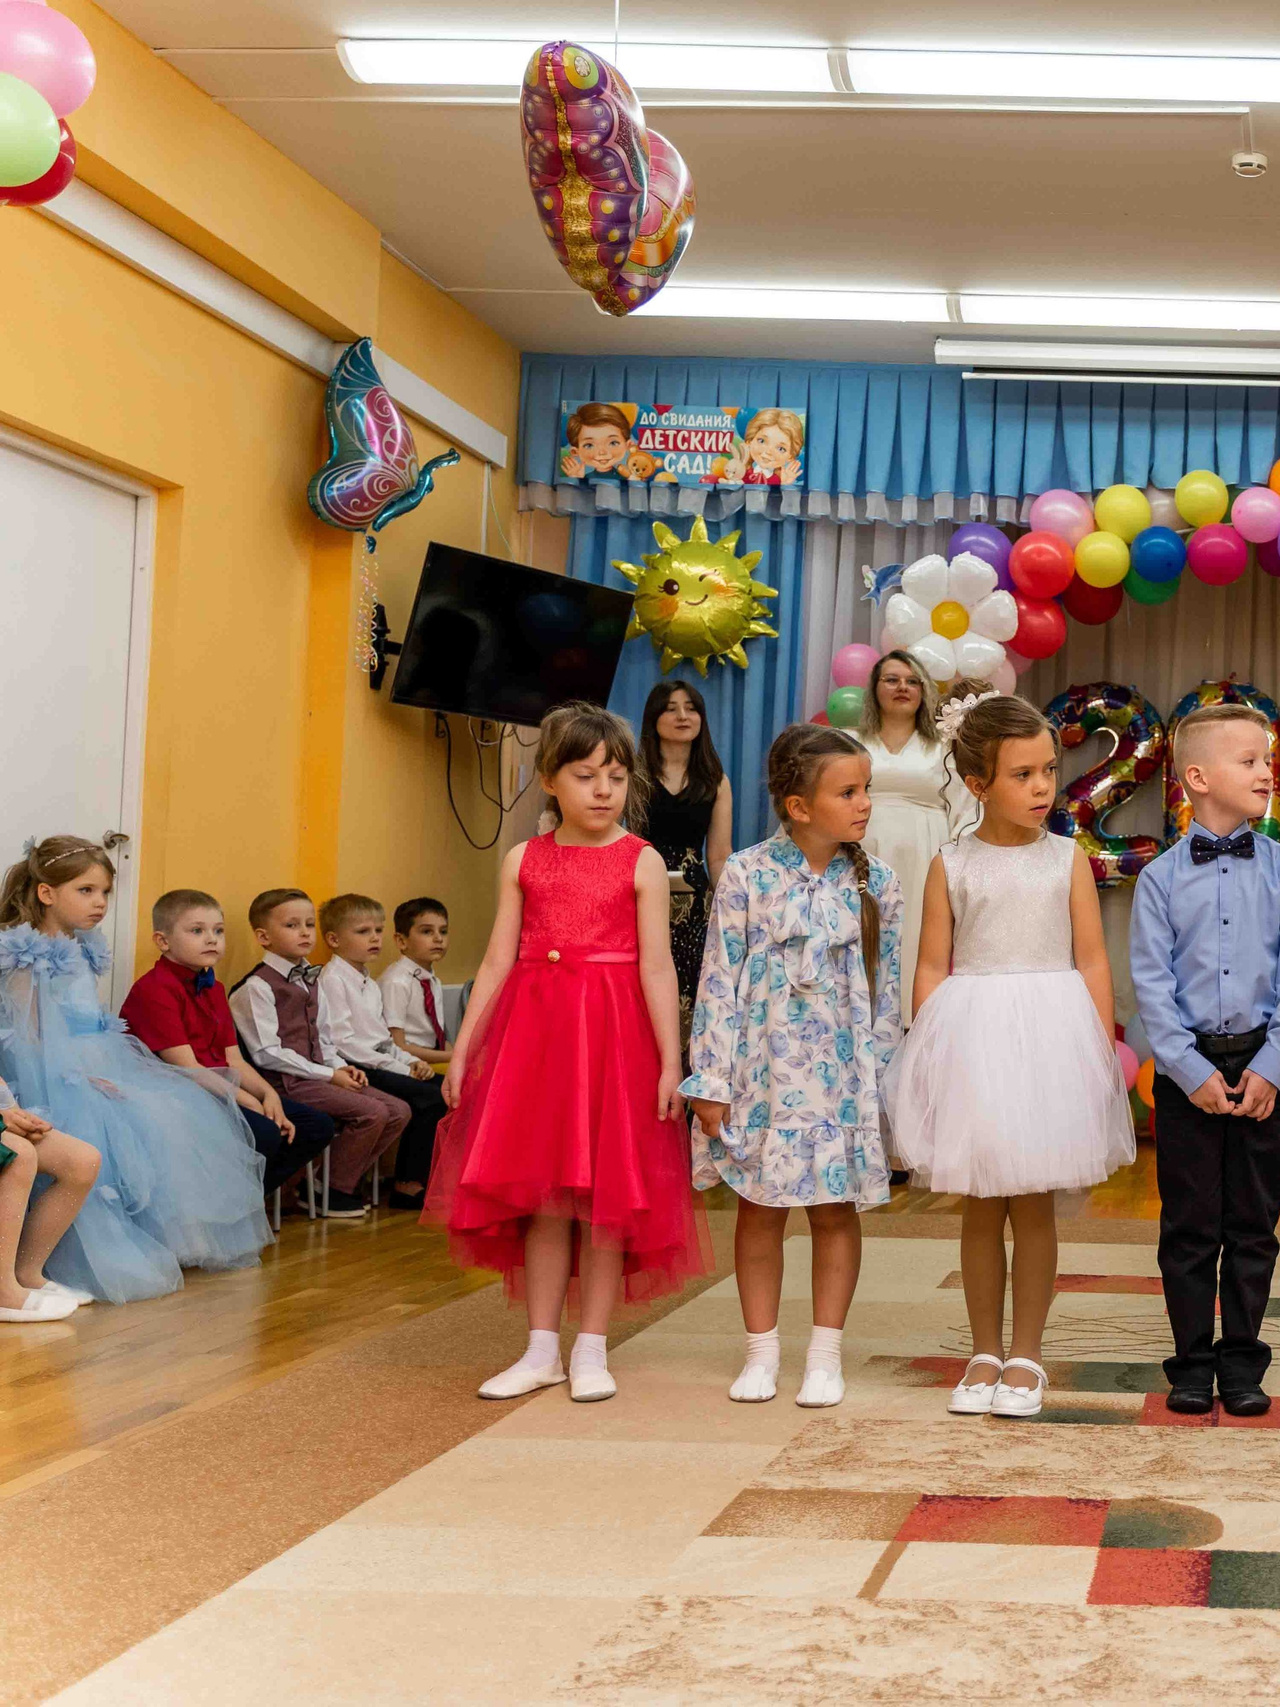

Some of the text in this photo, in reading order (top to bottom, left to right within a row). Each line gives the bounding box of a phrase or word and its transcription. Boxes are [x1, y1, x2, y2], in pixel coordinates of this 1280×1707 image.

[640, 412, 657, 425] ДО
[639, 429, 731, 452] ДЕТСКИЙ
[664, 453, 711, 474] САД!
